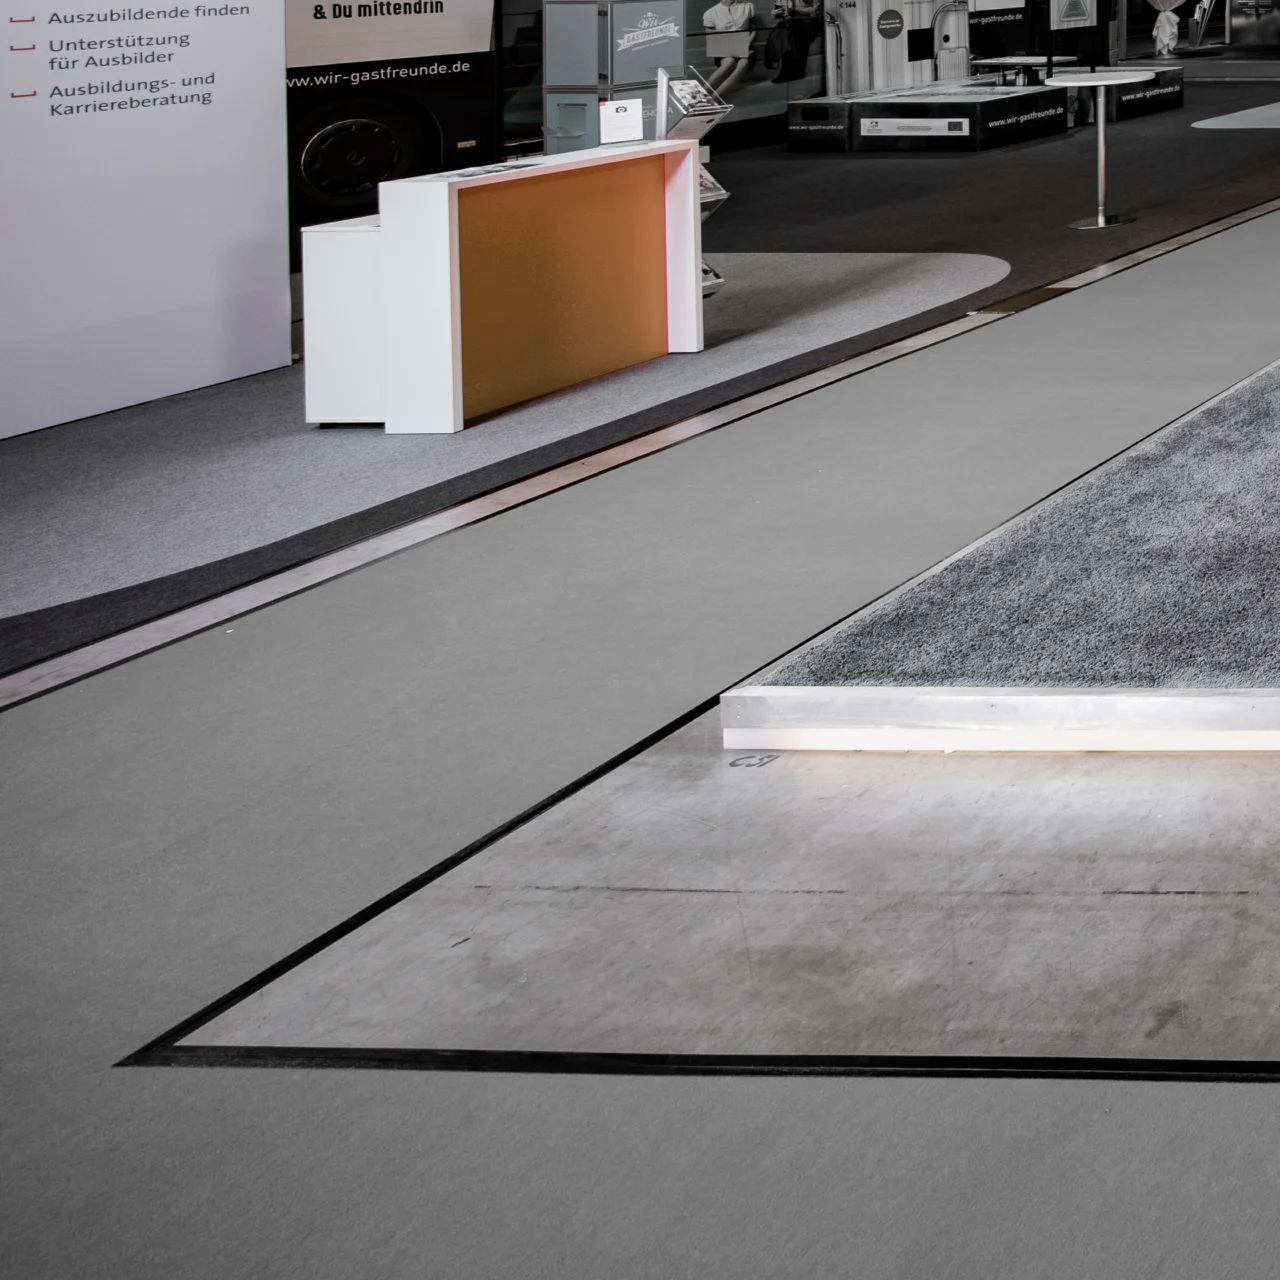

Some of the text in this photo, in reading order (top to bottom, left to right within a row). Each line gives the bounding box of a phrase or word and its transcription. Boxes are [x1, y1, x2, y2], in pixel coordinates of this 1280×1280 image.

[47, 4, 250, 25] Auszubildende finden
[313, 3, 328, 20] &
[332, 2, 353, 19] Du
[49, 34, 191, 53] Unterstützung
[626, 24, 672, 44] GASTFREUNDE
[48, 51, 175, 71] für Ausbilder
[286, 61, 471, 88] w.wir-gastfreunde.de
[49, 72, 216, 99] Ausbildungs- und
[50, 92, 213, 117] Karriereberatung
[988, 107, 1064, 128] www.wir-gastfreunde.de
